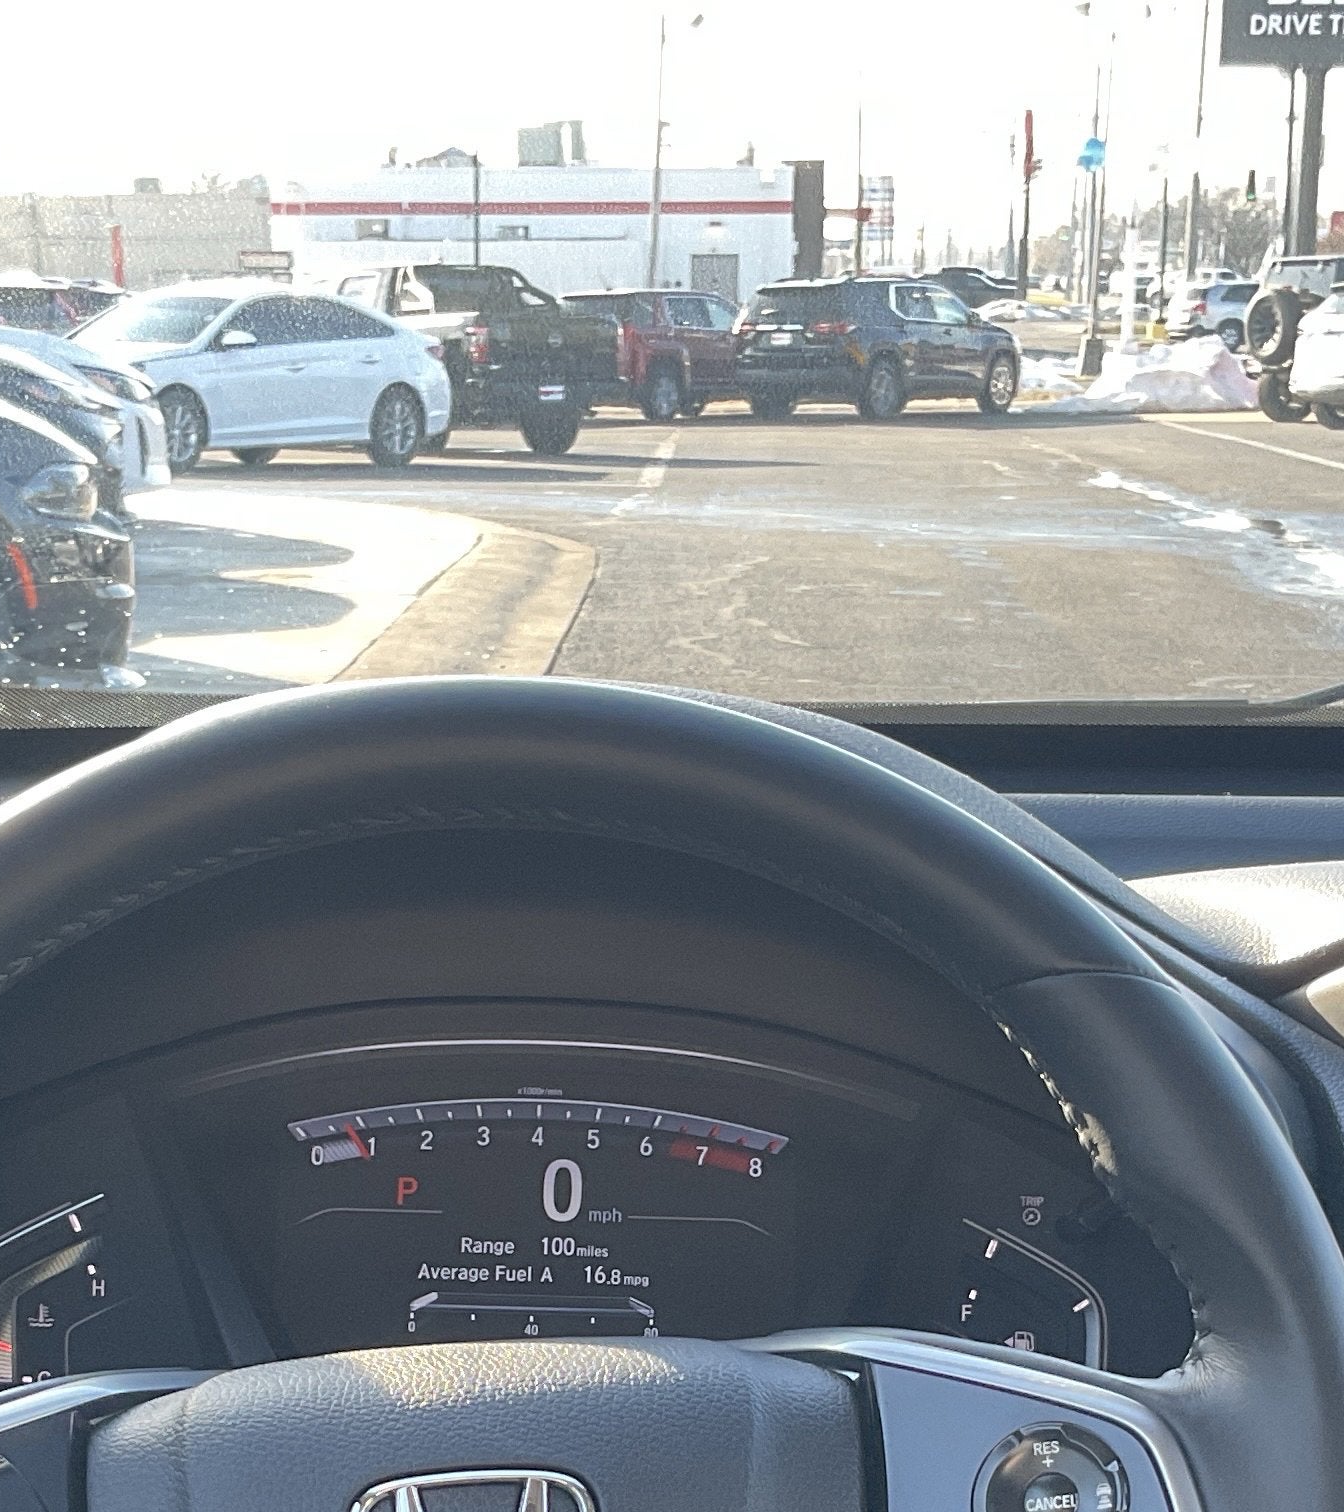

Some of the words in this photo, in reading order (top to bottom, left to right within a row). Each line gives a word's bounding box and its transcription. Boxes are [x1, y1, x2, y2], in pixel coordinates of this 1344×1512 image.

[1249, 13, 1322, 36] DRIVE
[419, 1131, 434, 1150] 2
[477, 1127, 491, 1147] 3
[531, 1127, 545, 1146] 4
[586, 1130, 600, 1150] 5
[310, 1146, 324, 1166] 0
[367, 1137, 376, 1157] 1
[640, 1137, 653, 1157] 6
[695, 1146, 709, 1166] 7
[749, 1158, 763, 1178] 8
[395, 1177, 419, 1205] P
[542, 1158, 583, 1223] 0
[588, 1207, 622, 1226] mph
[1020, 1196, 1044, 1207] TRIP
[460, 1236, 516, 1258] Range
[541, 1237, 575, 1257] 100
[417, 1262, 490, 1285] Average
[495, 1263, 533, 1283] Fuel
[540, 1266, 553, 1284] A
[583, 1266, 622, 1286] 16.8
[91, 1280, 105, 1297] H
[960, 1304, 972, 1322] F
[407, 1321, 416, 1333] 0
[524, 1323, 539, 1336] 40
[1033, 1440, 1060, 1456] RES
[1026, 1495, 1077, 1512] CANCEL
